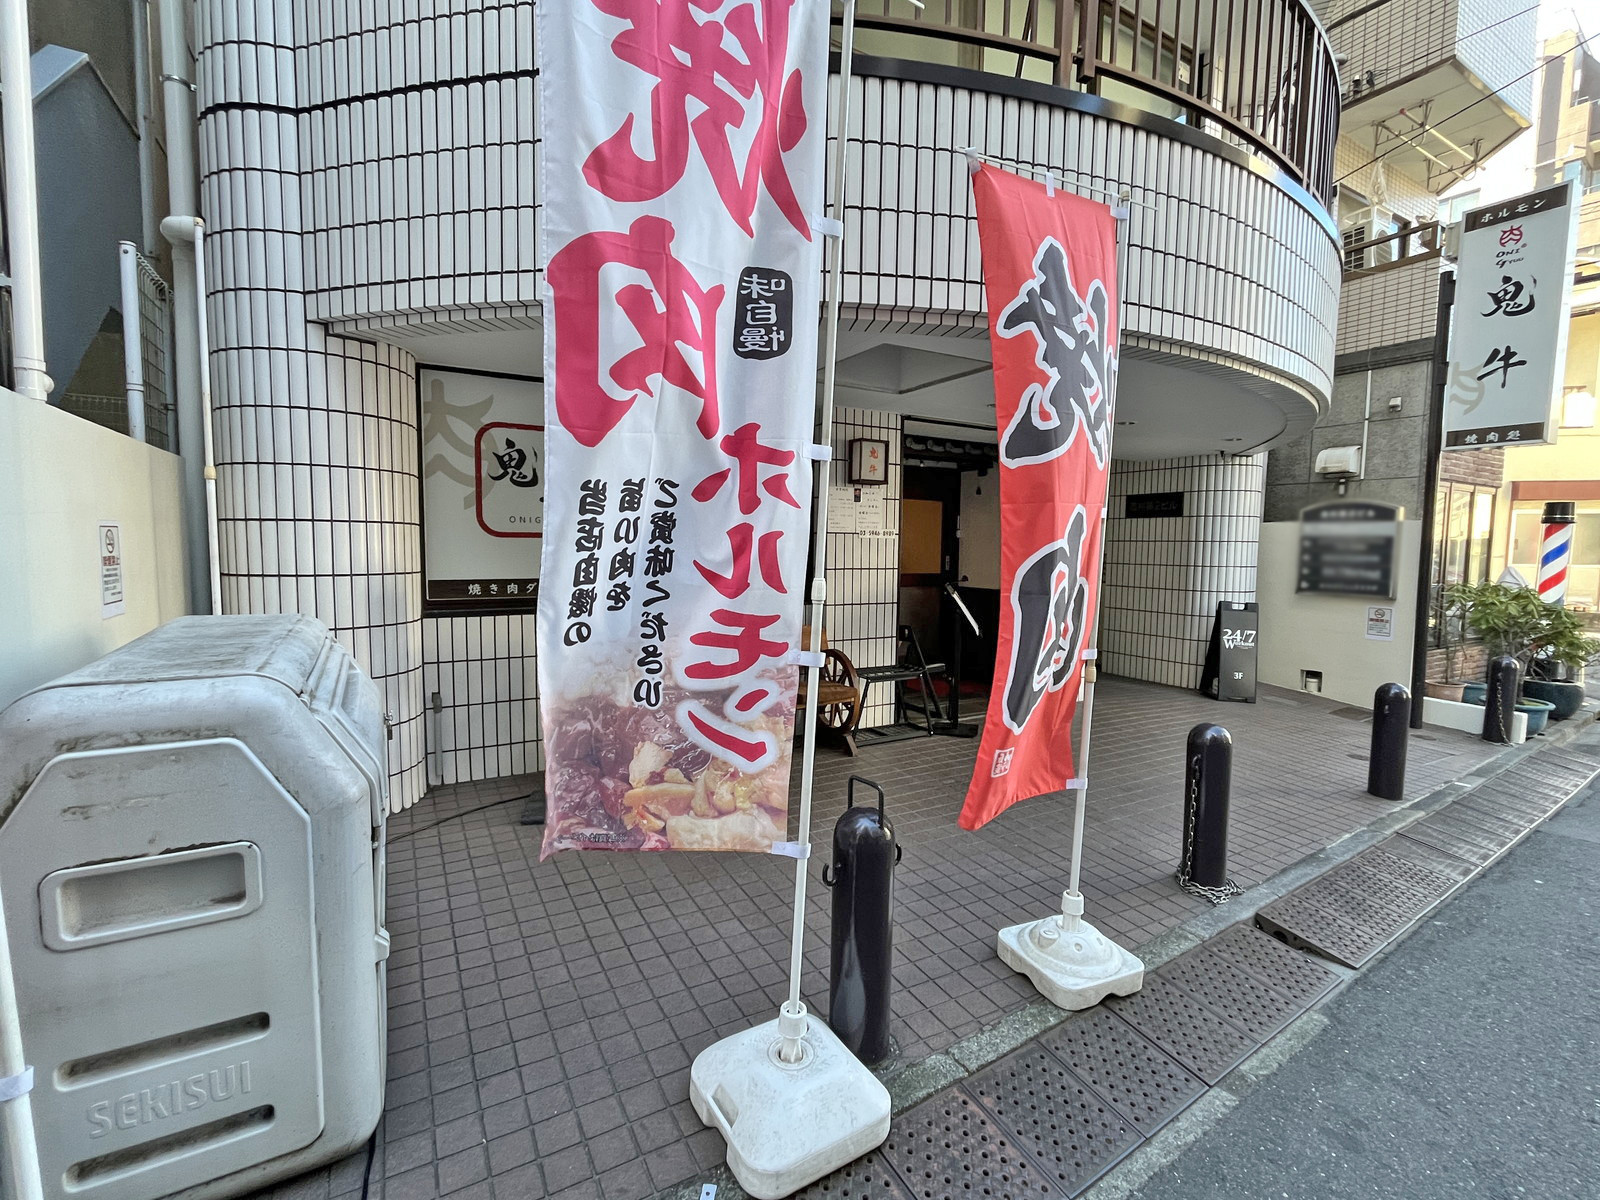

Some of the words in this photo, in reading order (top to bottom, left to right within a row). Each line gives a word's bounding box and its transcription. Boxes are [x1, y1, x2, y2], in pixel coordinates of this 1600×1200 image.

[1480, 198, 1547, 223] ホルモン
[1495, 248, 1521, 258] ONI
[1476, 273, 1537, 389] 鬼牛
[1222, 628, 1257, 643] 24/7
[1233, 672, 1244, 680] 3F
[86, 1060, 254, 1139] SEKISUI
